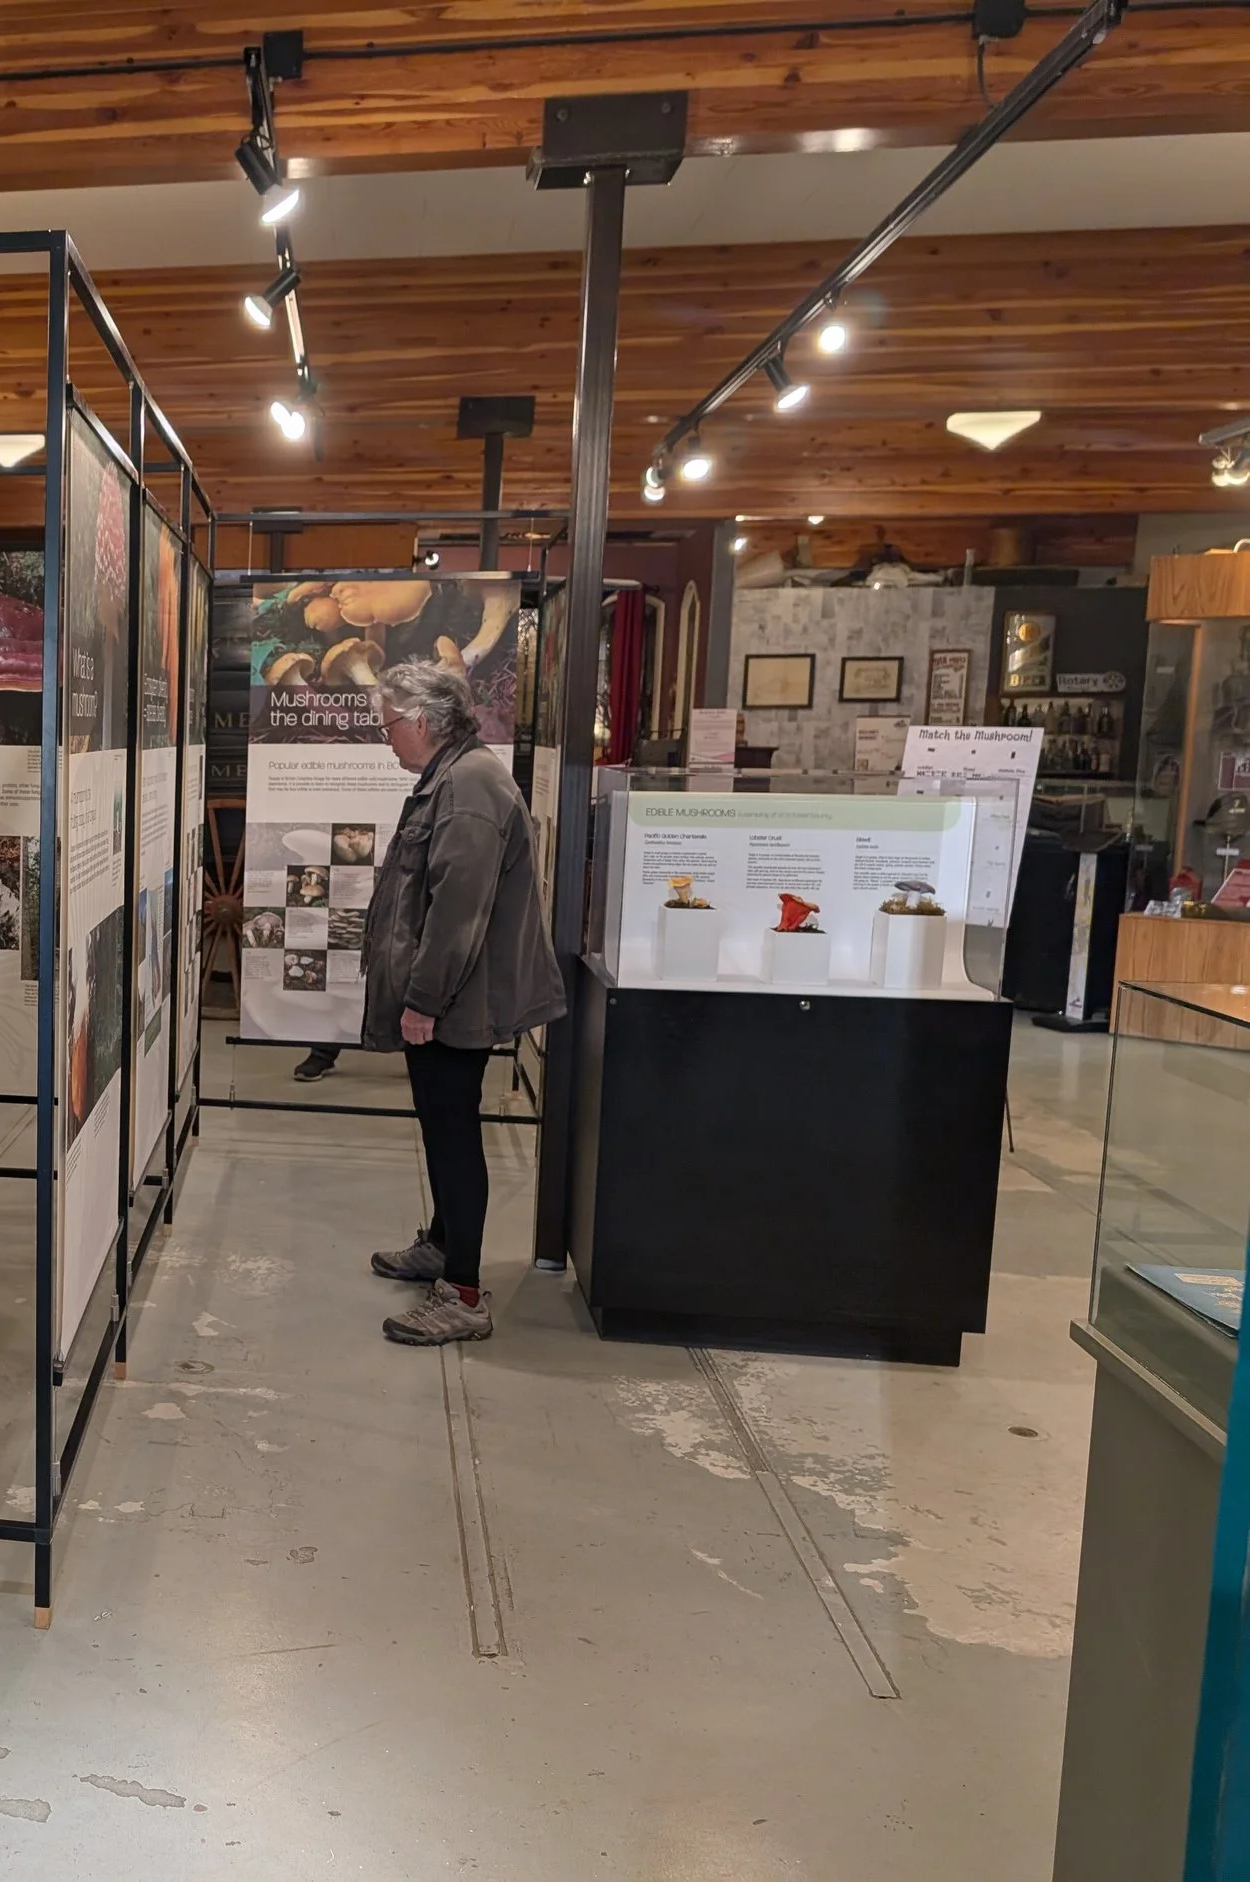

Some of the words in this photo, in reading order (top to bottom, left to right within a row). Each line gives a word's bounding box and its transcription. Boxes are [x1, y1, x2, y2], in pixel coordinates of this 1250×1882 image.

[270, 691, 367, 707] Mushrooms
[270, 710, 297, 726] the
[301, 710, 349, 730] dining
[354, 710, 384, 726] tabl
[919, 729, 950, 741] Match
[954, 730, 971, 740] the
[974, 730, 1033, 742] Mushroom!
[268, 761, 298, 770] Popular
[302, 761, 325, 770] edible
[327, 761, 375, 770] mushrooms
[378, 762, 385, 770] in
[646, 808, 674, 817] EDIBLE
[676, 808, 736, 818] MUSHROOMS
